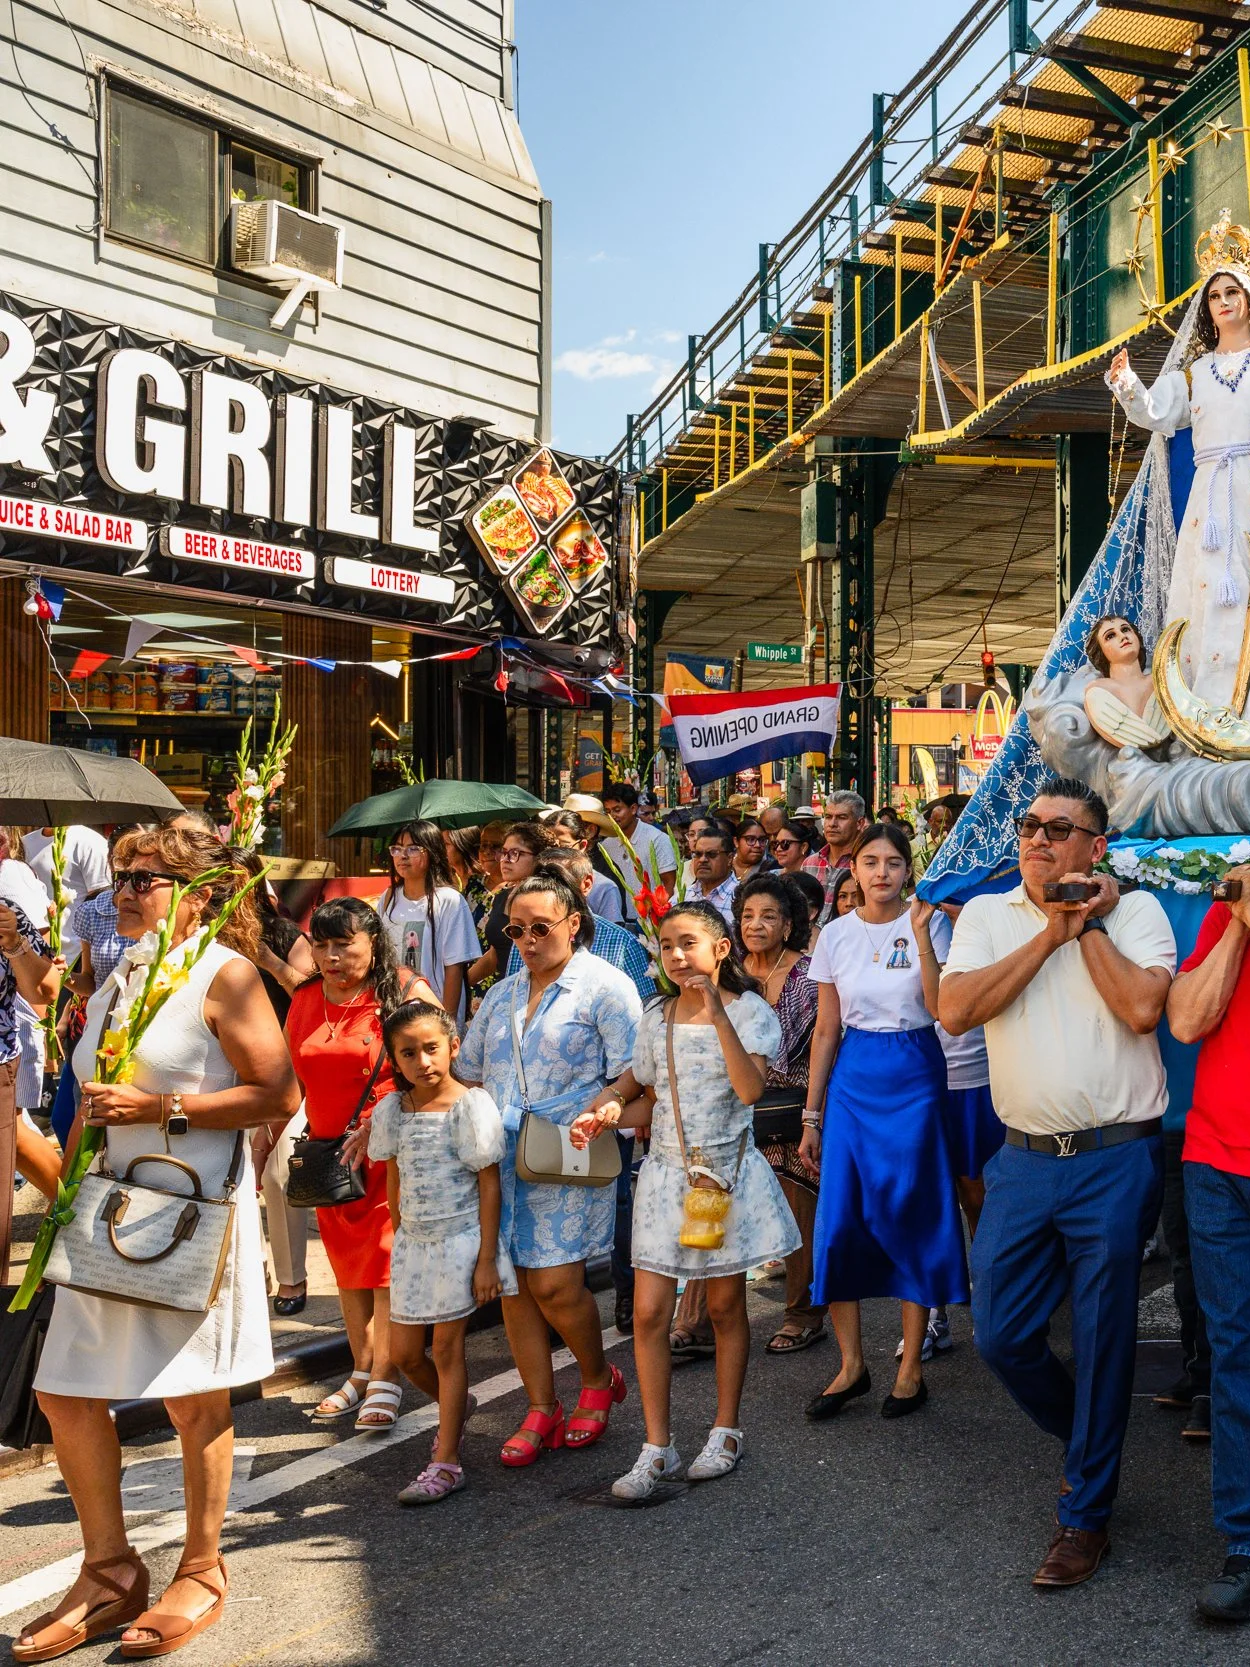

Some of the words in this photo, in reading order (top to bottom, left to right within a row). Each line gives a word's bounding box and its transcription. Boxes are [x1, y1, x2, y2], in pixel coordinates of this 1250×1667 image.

[0, 309, 57, 475] &
[103, 348, 440, 553] GRILL
[0, 500, 33, 527] UICE
[40, 507, 49, 529] &
[55, 510, 100, 538] SALAD
[106, 519, 132, 544] BAR
[185, 533, 217, 558] BEER
[222, 540, 229, 560] &
[234, 541, 302, 572] BEVERAGES
[371, 567, 420, 593] LOTTERY
[755, 646, 787, 660] Whipple
[791, 647, 797, 655] St
[585, 752, 600, 760] GET
[975, 742, 998, 751] McD
[105, 1266, 127, 1275] DKNY
[132, 1272, 154, 1281] DKNY
[159, 1278, 181, 1287] DKNY
[149, 1266, 171, 1275] DKNY
[176, 1272, 198, 1280] DKNY
[116, 1278, 138, 1287] DKNY
[144, 1283, 166, 1292] DKNY
[171, 1289, 193, 1297] DKNY
